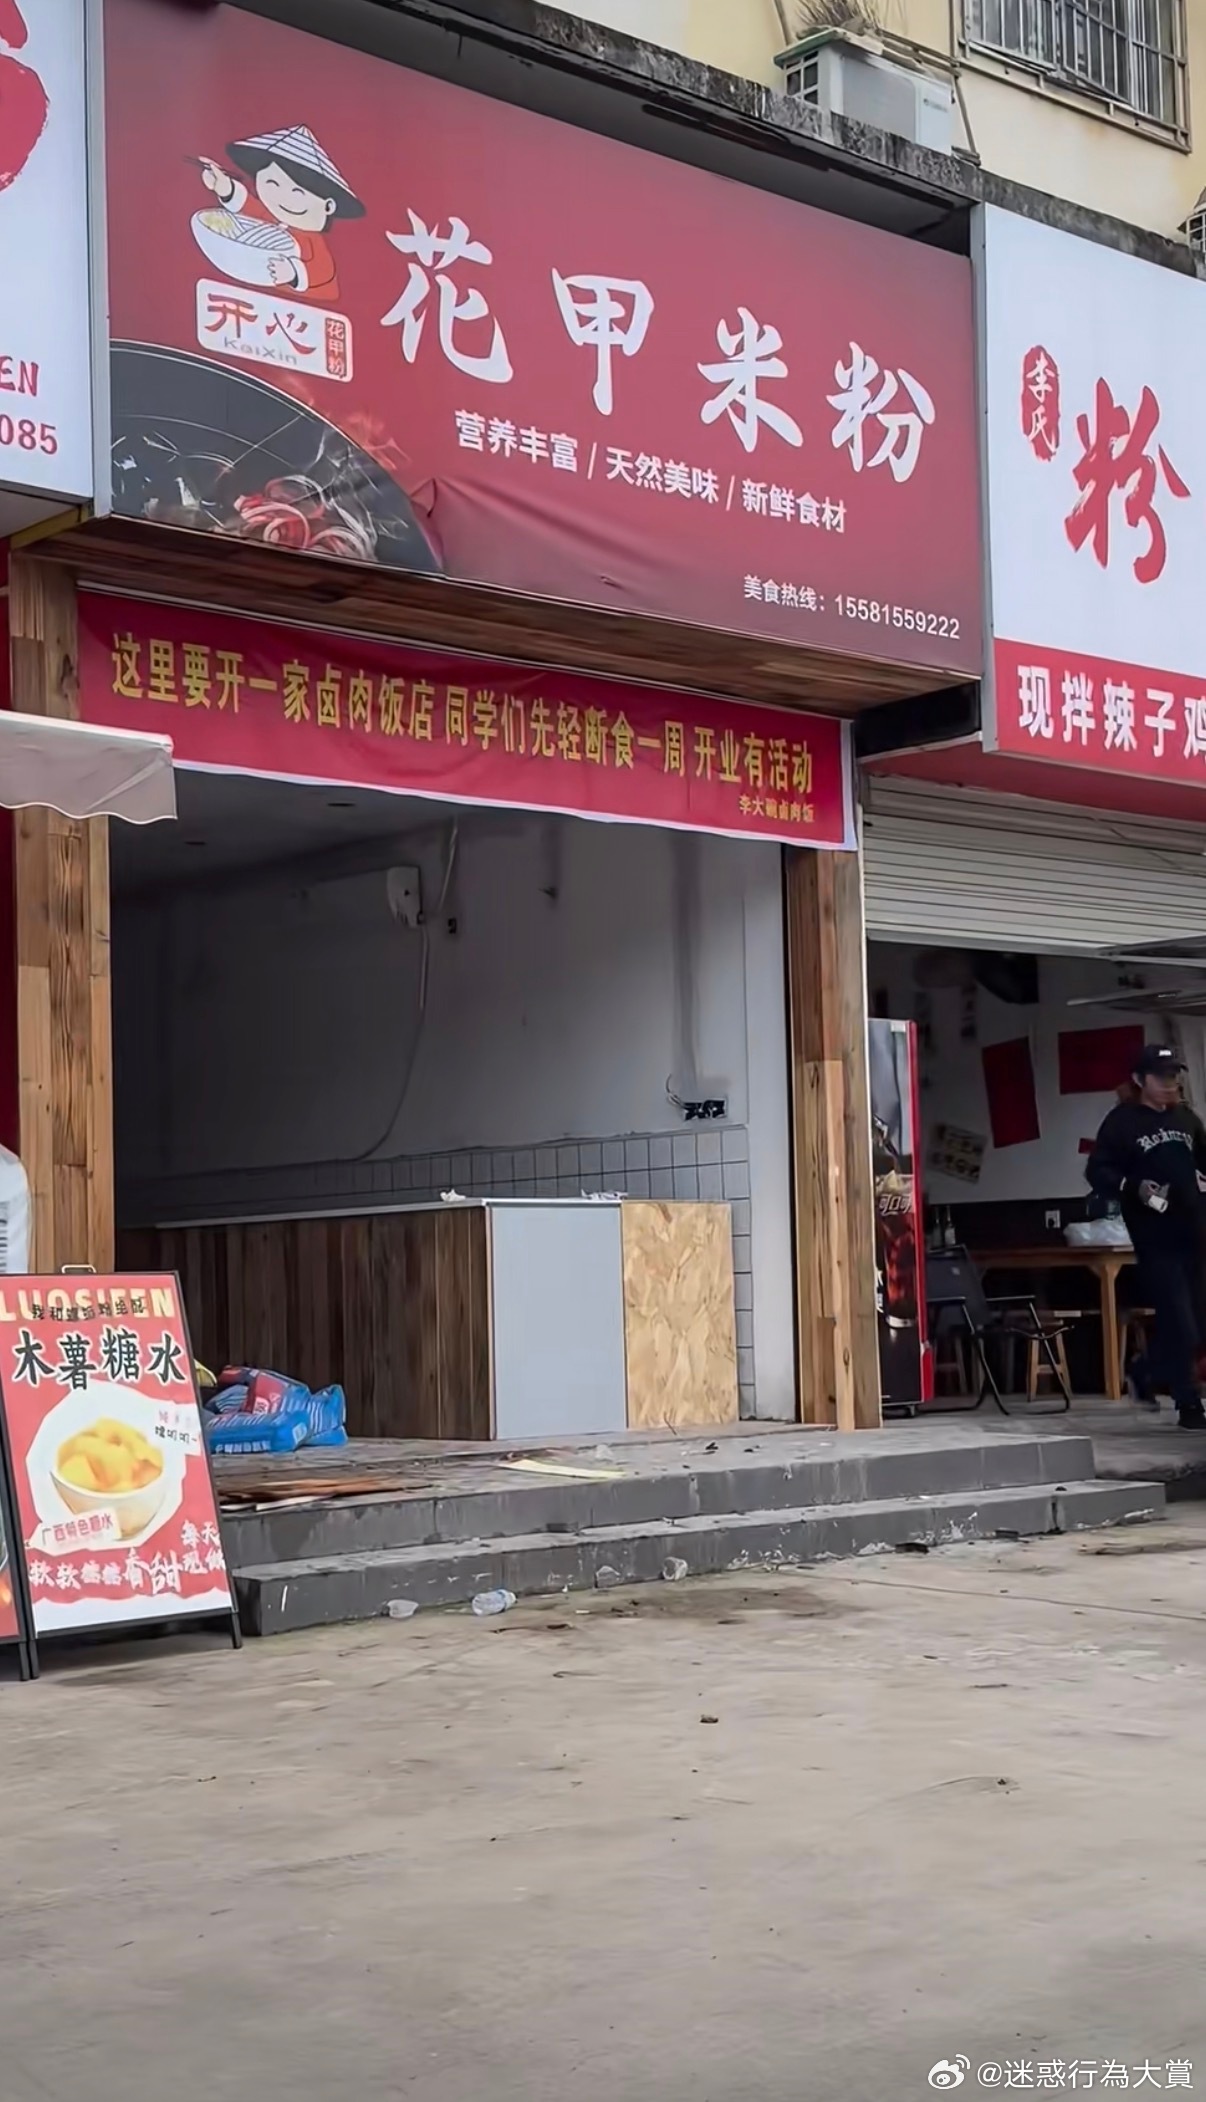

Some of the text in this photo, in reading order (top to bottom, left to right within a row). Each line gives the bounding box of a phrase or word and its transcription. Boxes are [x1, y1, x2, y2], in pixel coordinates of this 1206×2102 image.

[205, 293, 317, 355] 开心
[224, 337, 298, 365] KaiXin
[326, 319, 347, 377] 花甲粉
[379, 207, 936, 483] 花甲米粉
[0, 413, 58, 455] 085
[1025, 350, 1058, 455] 李氏
[454, 409, 578, 473] 营养丰富
[606, 445, 719, 504] 天然美味
[741, 477, 847, 534] 新鲜食材
[1064, 376, 1191, 584] 粉
[834, 594, 961, 640] 15581559222
[112, 631, 813, 794] 这里要开一家卤肉饭店 同学们先轻断食一周 开业有活动
[13, 1326, 187, 1391] 木薯糖水
